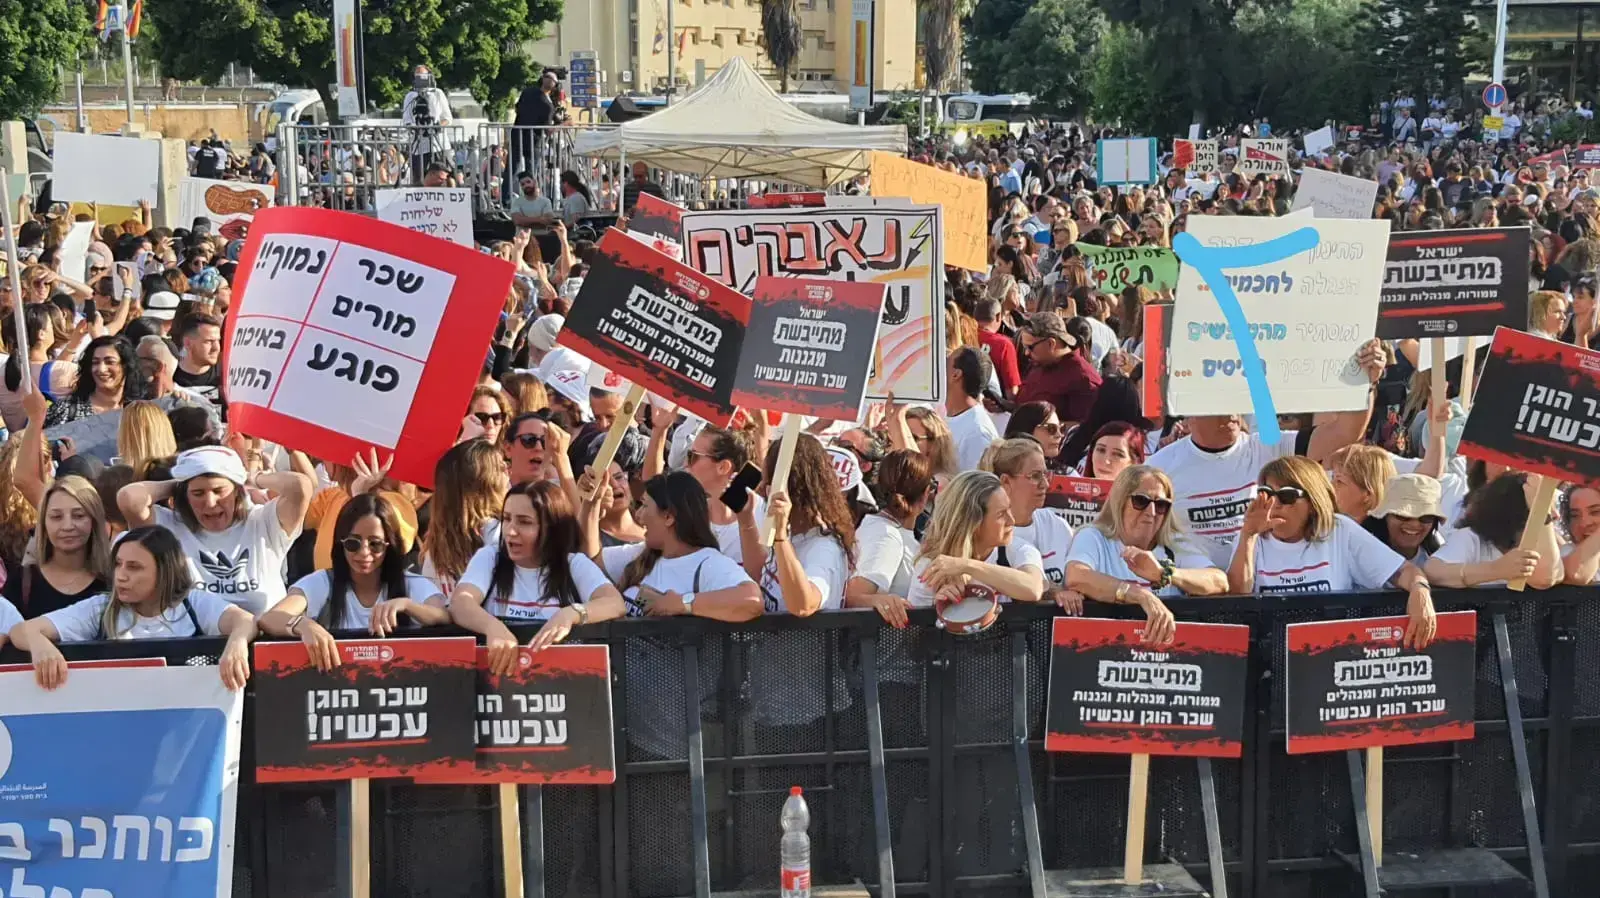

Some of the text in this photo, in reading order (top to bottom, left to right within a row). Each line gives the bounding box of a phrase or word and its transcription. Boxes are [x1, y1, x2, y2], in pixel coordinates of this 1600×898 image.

[405, 192, 465, 202] עם תחושת
[400, 206, 443, 220] שליחות
[443, 220, 458, 232] לא
[256, 241, 326, 280] נמוך!!
[688, 217, 903, 286] נאבקים
[1416, 246, 1463, 258] ישראל
[358, 259, 424, 294] שכר
[1384, 262, 1496, 284] מתייבשת
[664, 288, 699, 312] ישראל
[1410, 290, 1451, 302] מנהלות
[1454, 290, 1498, 300] ממורות,
[332, 295, 416, 338] מורים
[631, 293, 717, 347] מתייבשת
[800, 306, 827, 319] ישראל
[234, 327, 286, 350] באיכות
[611, 308, 715, 368] ממנהלות ומנהלים
[776, 323, 842, 345] מתייבשת
[596, 318, 717, 388] שכר הוגן עכשיו!
[779, 348, 827, 368] מגננות
[307, 343, 400, 392] פוגע
[754, 364, 848, 388] שכר הוגן עכשיו!
[1522, 383, 1574, 411] הוגן
[1514, 404, 1600, 450] כשיו!
[1068, 498, 1098, 510] ישראל
[194, 579, 259, 594] adidas
[1280, 576, 1306, 584] ישראל
[508, 608, 538, 617] ישראל
[1130, 649, 1170, 662] ישראל
[1363, 647, 1400, 658] ישראל
[1104, 665, 1198, 686] מתייבשת
[1340, 660, 1427, 682] מתייבשת
[308, 687, 428, 713] שכר הוגן
[512, 694, 566, 712] שכר
[1072, 691, 1221, 708] ממורות, מנהלות וגננות
[1326, 684, 1436, 702] ממנהלות ומנהלים
[1080, 706, 1214, 726] שכר הוגן עכשיו!
[1319, 699, 1446, 721] שכר הוגן עכשיו!
[308, 712, 428, 740] עכשיו!
